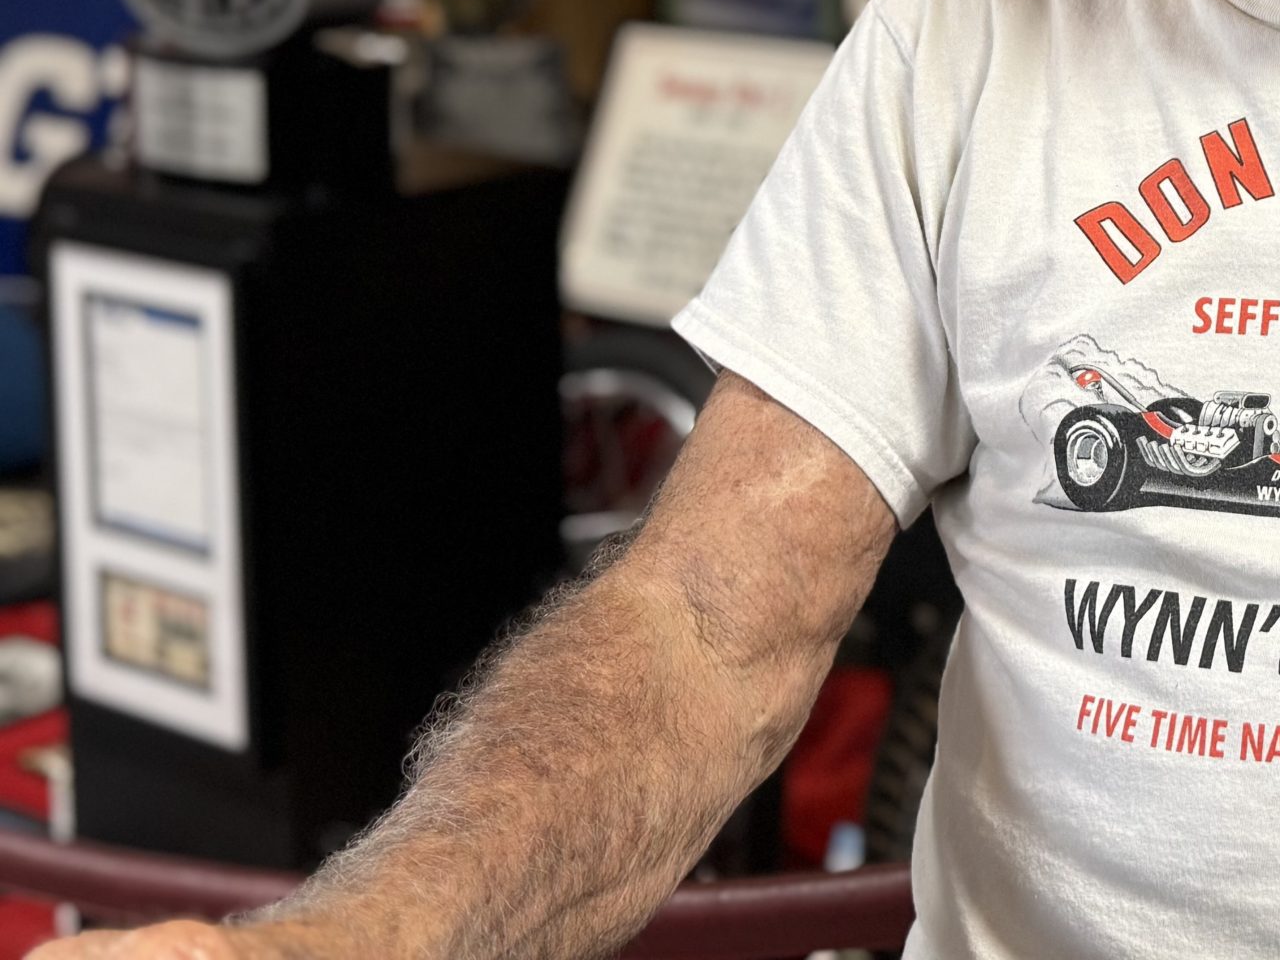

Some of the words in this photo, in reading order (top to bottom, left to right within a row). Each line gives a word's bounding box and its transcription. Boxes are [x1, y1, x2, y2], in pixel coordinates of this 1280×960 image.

[1074, 118, 1275, 285] DON
[1077, 695, 1141, 743] FIVE
[1151, 710, 1228, 758] TIME
